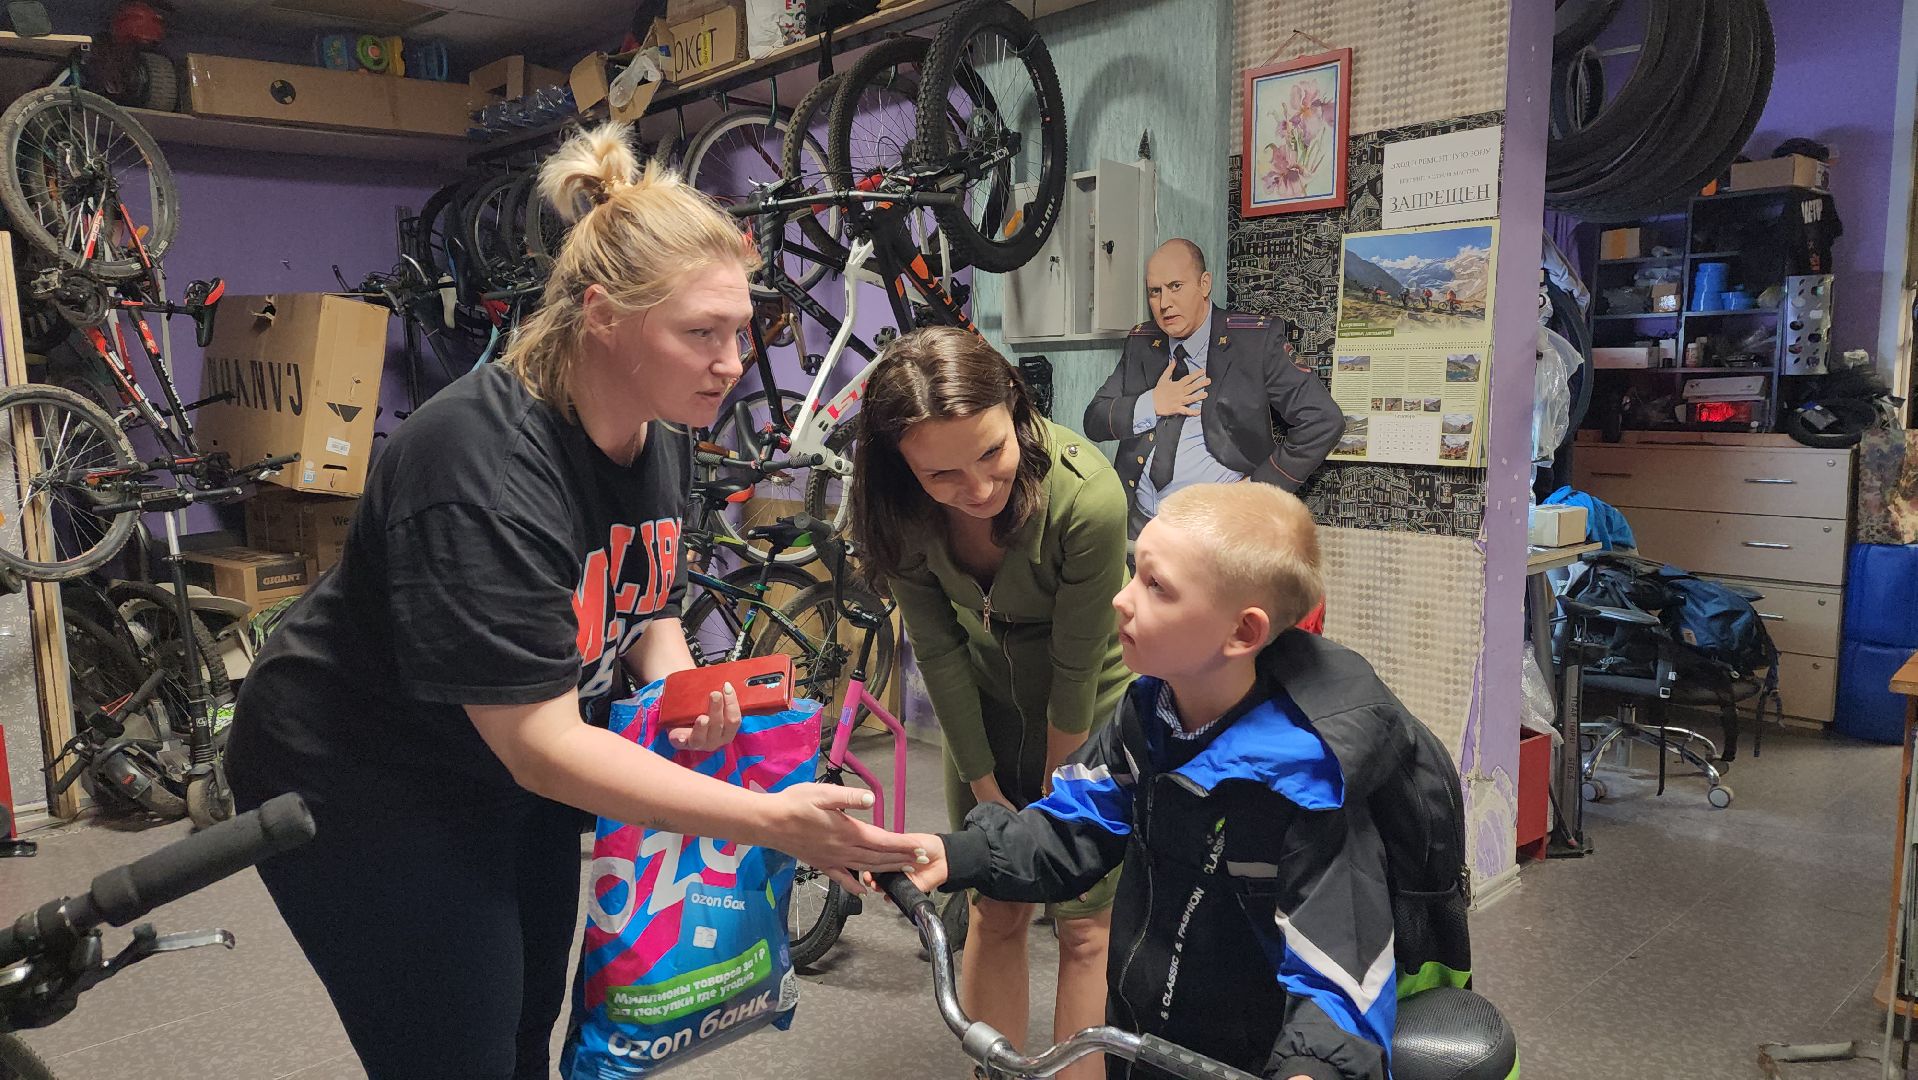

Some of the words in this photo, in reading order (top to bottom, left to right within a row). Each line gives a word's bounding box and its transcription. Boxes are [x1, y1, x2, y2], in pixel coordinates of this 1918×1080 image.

[1389, 183, 1491, 212] ЗАПРЕЩЕН
[262, 573, 301, 586] GIGANT
[571, 516, 683, 668] MLIB
[691, 893, 722, 908] ozon
[1177, 886, 1205, 939] FASHION
[1175, 942, 1183, 953] &
[614, 984, 690, 1005] Миллионы
[693, 964, 742, 990] товаров
[742, 959, 754, 972] за
[634, 995, 695, 1017] покупки
[696, 988, 718, 1003] где
[720, 971, 755, 997] угодно
[1162, 954, 1180, 1007] CLASSIC
[607, 1028, 693, 1061] ozon
[699, 990, 772, 1040] банк
